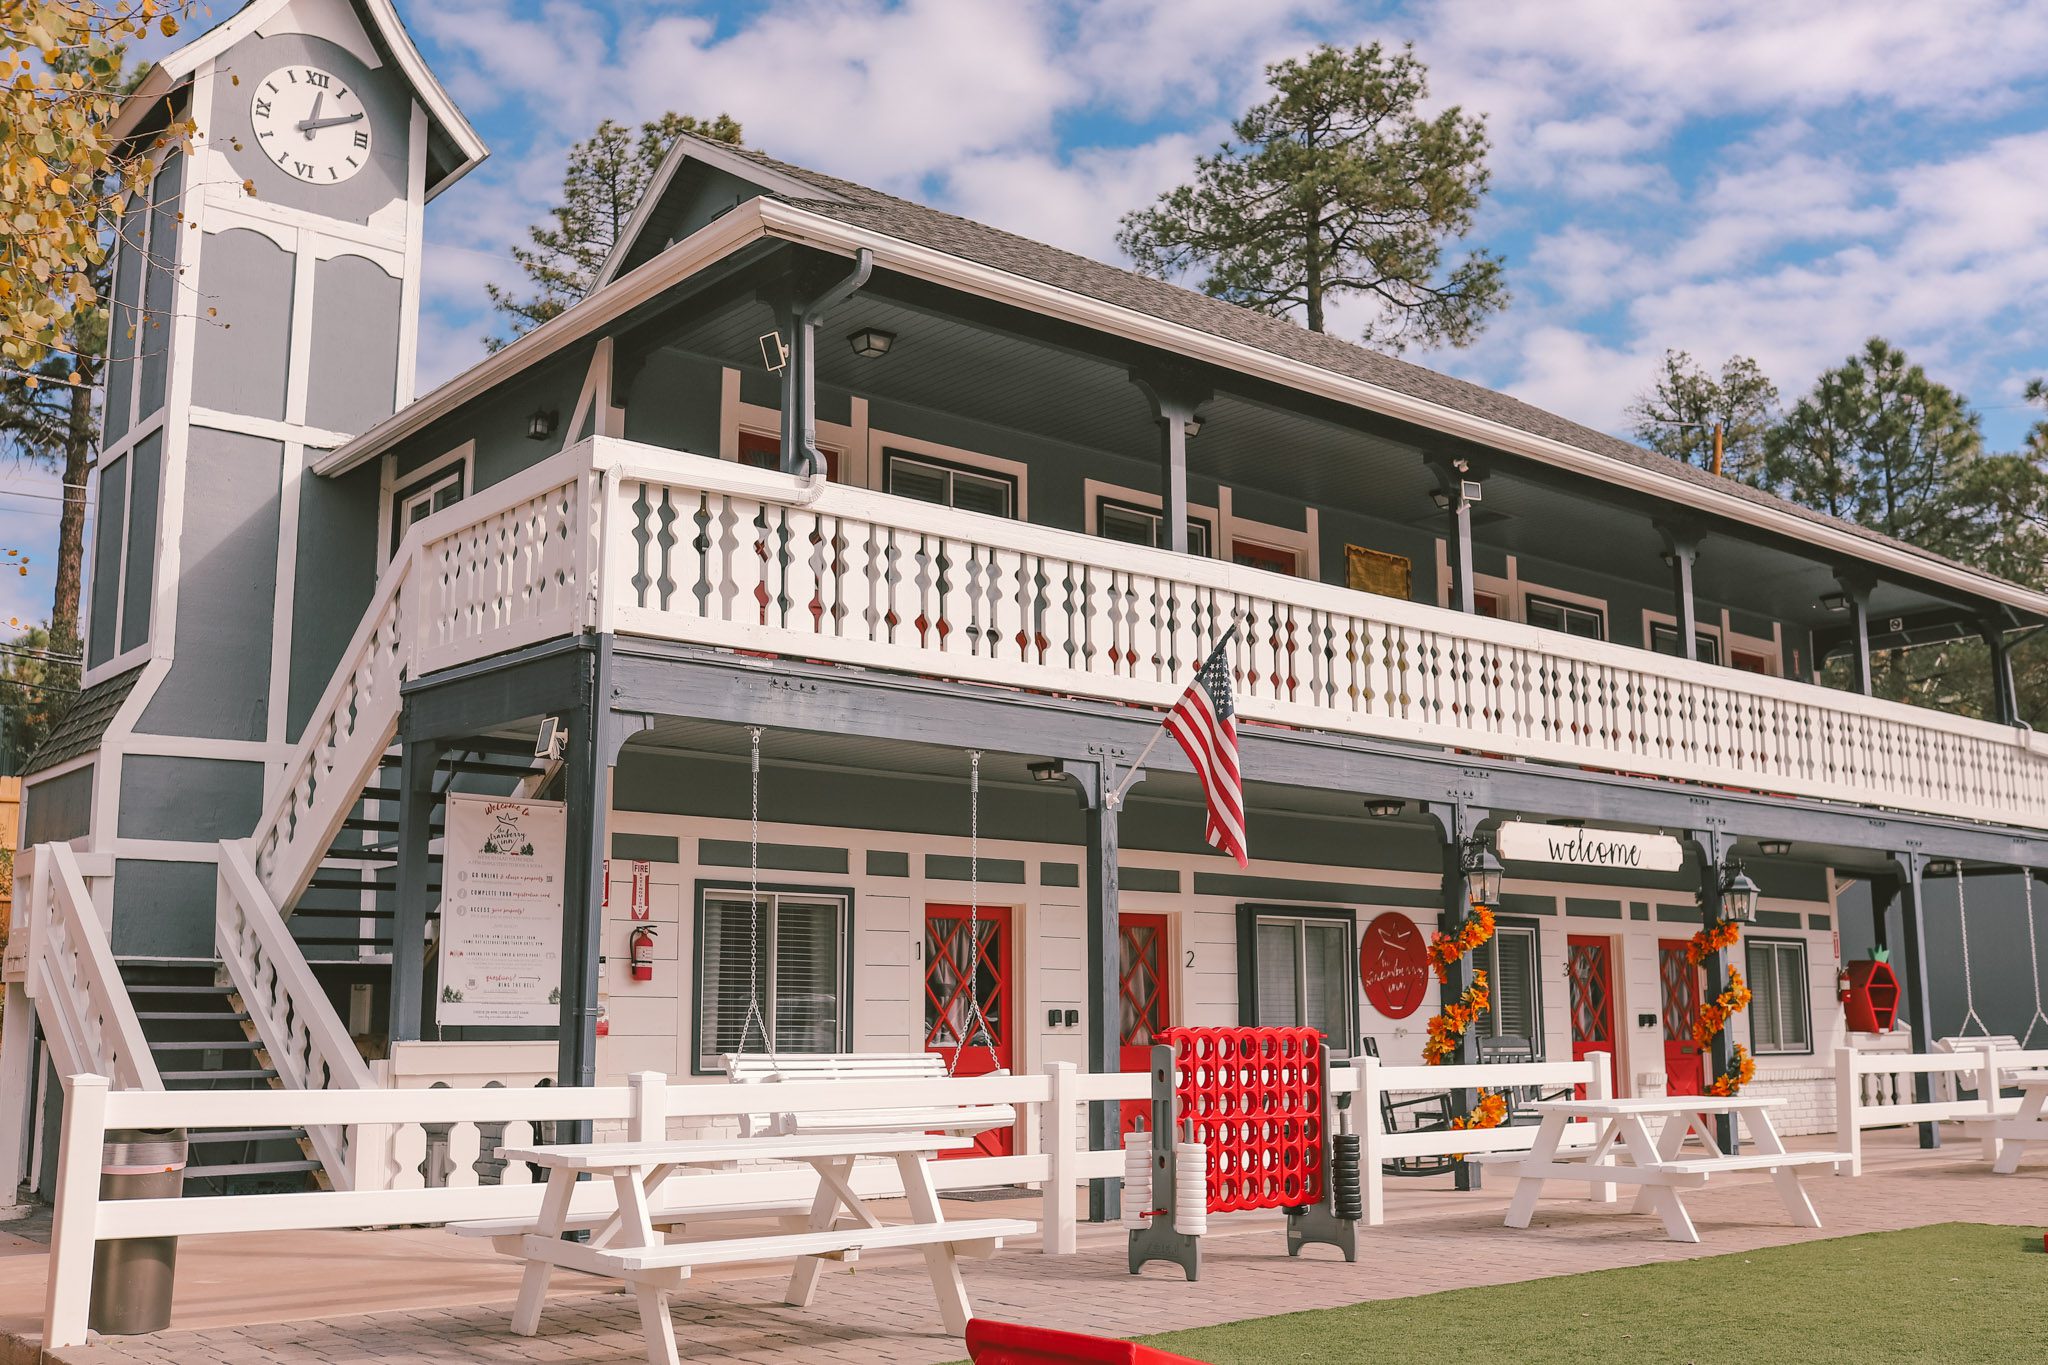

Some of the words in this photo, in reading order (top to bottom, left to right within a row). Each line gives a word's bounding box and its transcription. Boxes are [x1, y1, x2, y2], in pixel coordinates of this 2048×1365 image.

[306, 70, 329, 88] XII
[354, 130, 368, 150] III
[294, 161, 314, 178] VI
[484, 803, 520, 816] Welcome
[1548, 829, 1642, 866] welcome
[634, 864, 648, 873] FIRE
[1186, 950, 1195, 968] 2
[1562, 962, 1570, 976] 3
